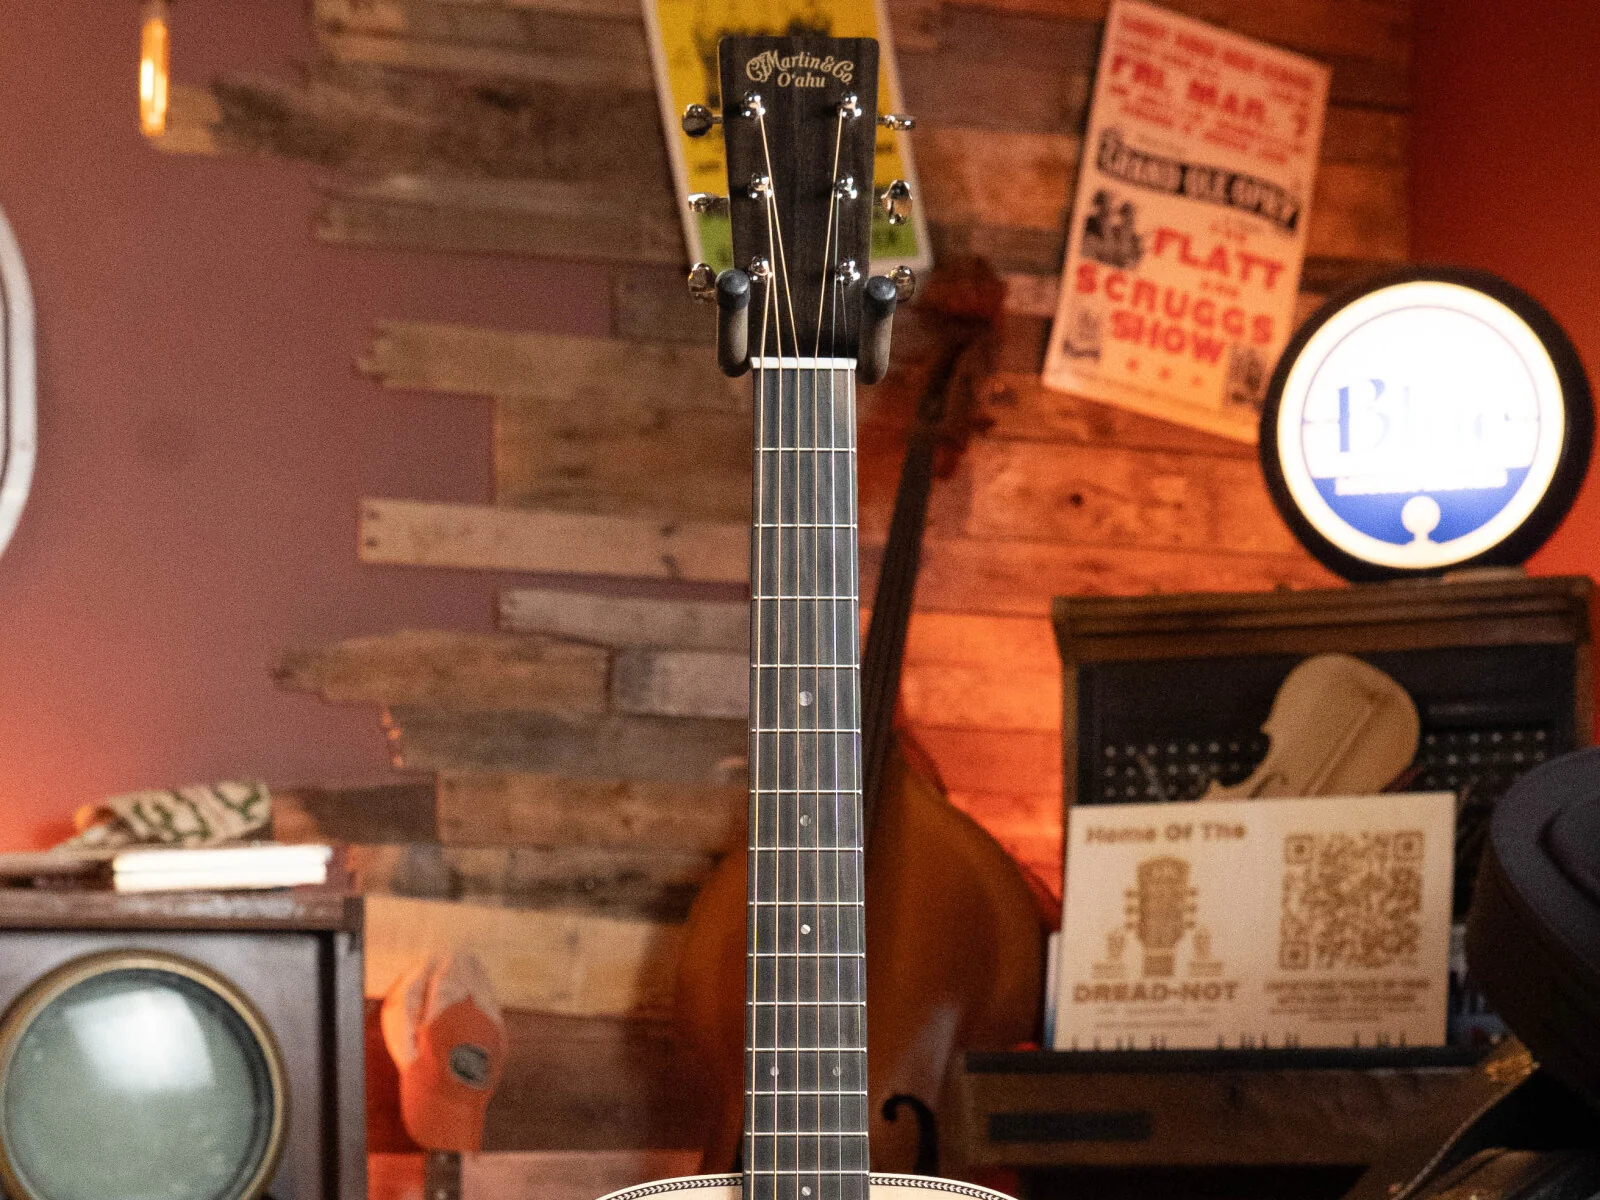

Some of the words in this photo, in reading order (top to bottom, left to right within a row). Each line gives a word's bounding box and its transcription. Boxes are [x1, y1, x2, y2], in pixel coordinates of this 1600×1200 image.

[1154, 227, 1287, 289] FLATT
[1075, 262, 1275, 345] SCRUGGS
[1109, 310, 1226, 364] SHOW
[1073, 980, 1241, 1003] DREAD-NOT
